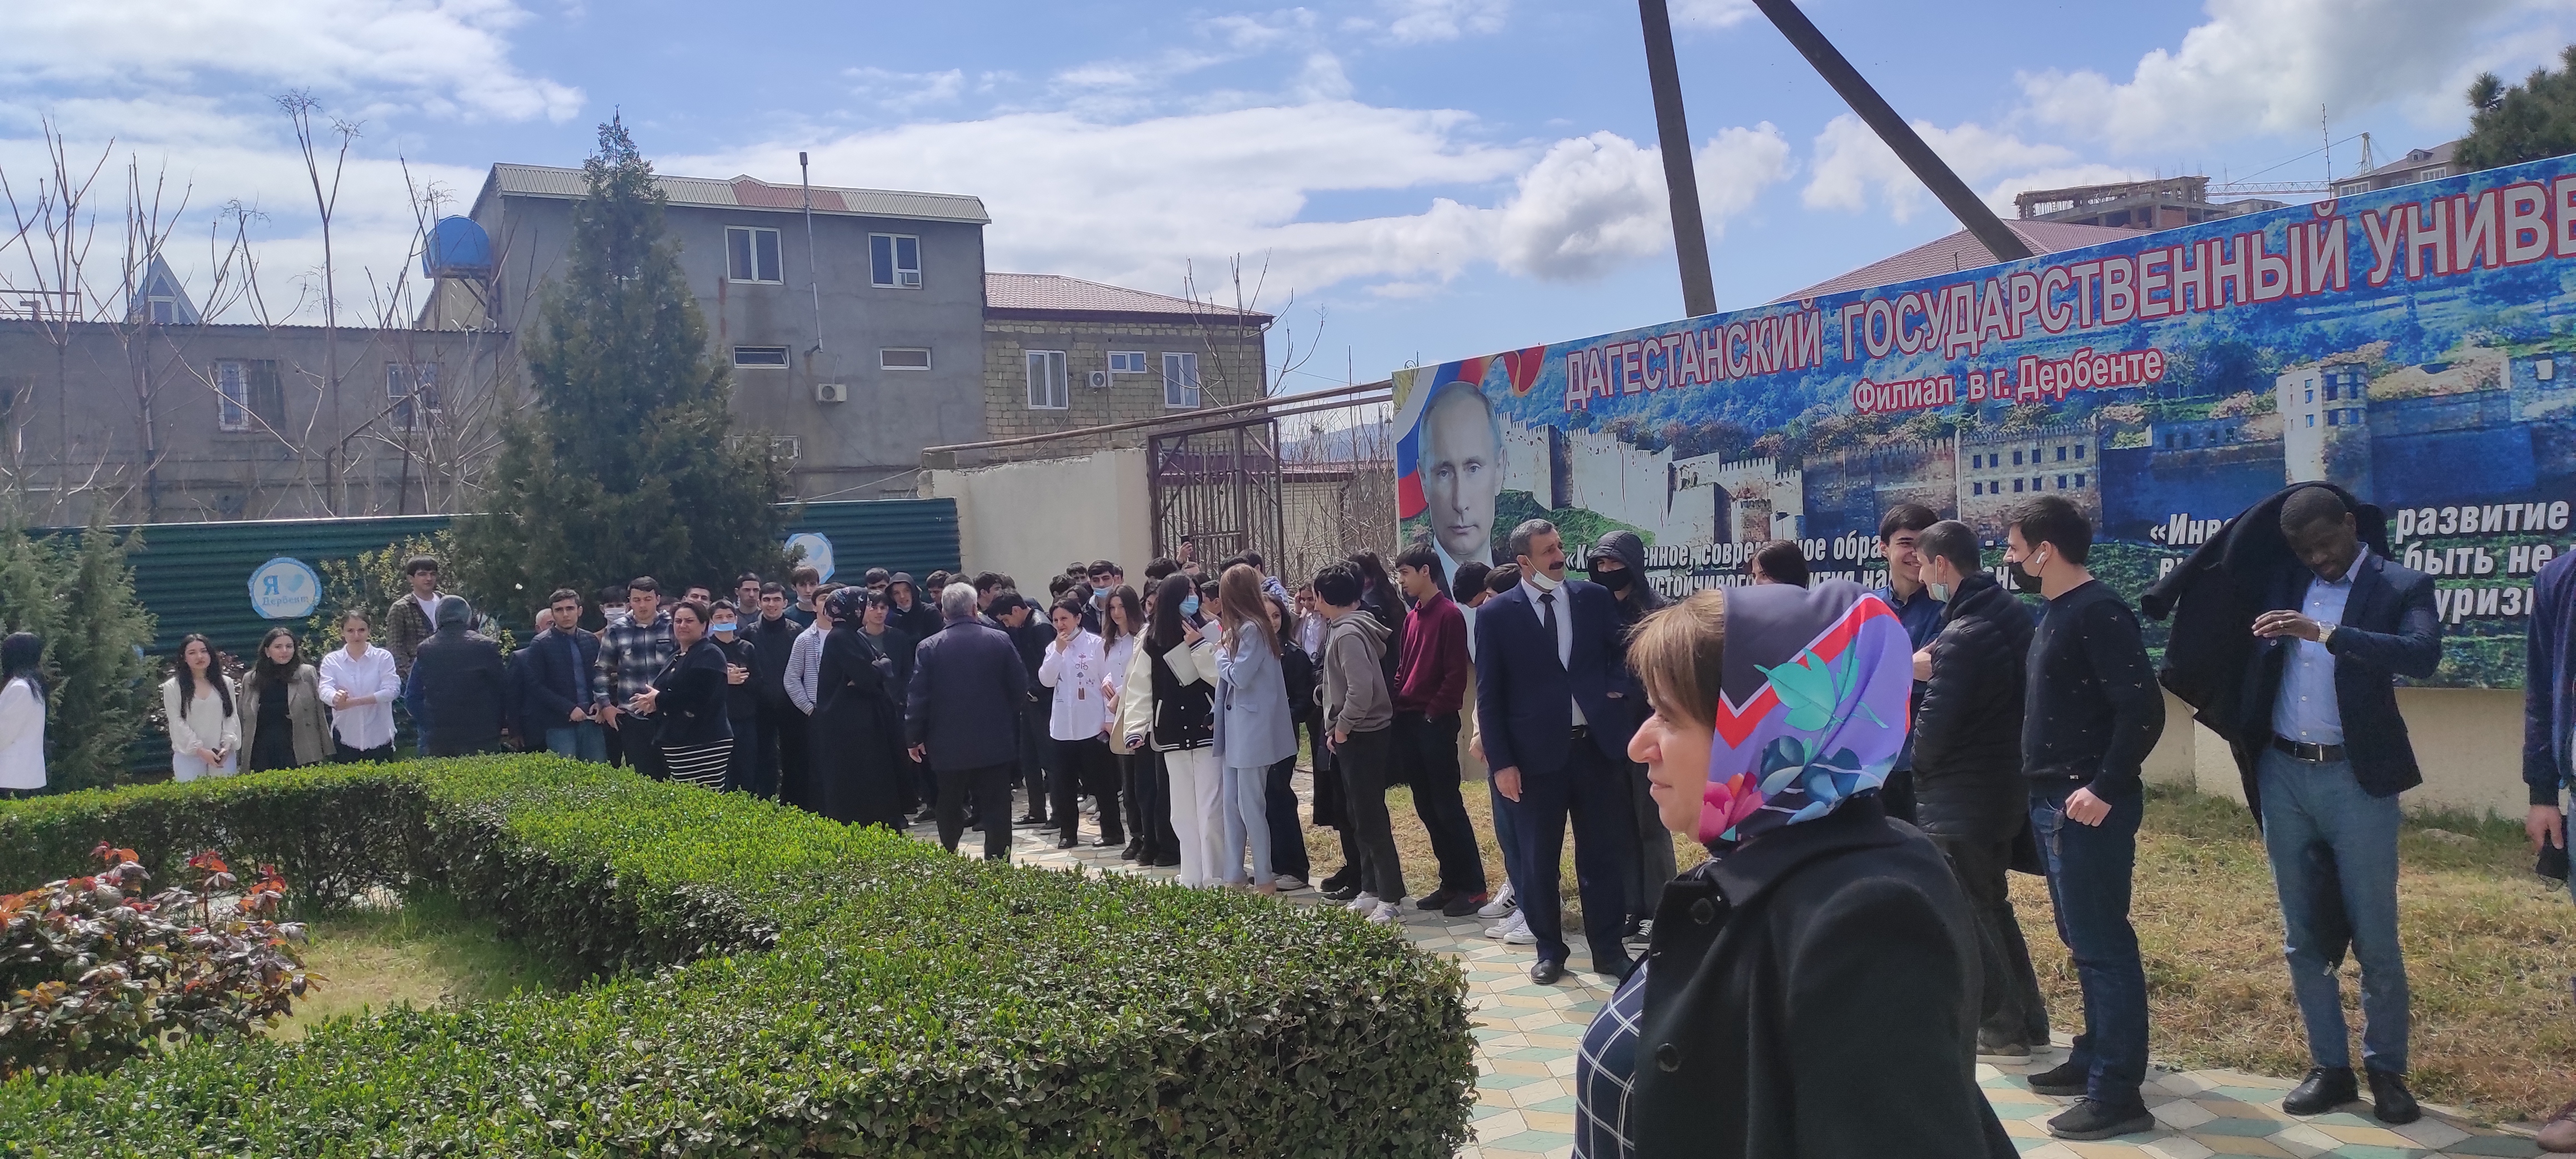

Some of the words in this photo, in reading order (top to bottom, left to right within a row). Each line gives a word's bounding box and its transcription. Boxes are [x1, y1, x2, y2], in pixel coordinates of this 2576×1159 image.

[1565, 298, 1822, 412] ДАГЕСТАНСКИЙ
[1843, 200, 2347, 360] ГОСУДАРСТВЕННЫЙ
[1855, 376, 1954, 412] Филиал
[1969, 373, 1986, 400] в
[1994, 372, 2010, 397] г.
[2017, 349, 2162, 400] Дербенте
[2394, 500, 2570, 545] развитие
[2403, 541, 2494, 575] быть
[2507, 544, 2553, 573] не
[263, 575, 279, 596] Я
